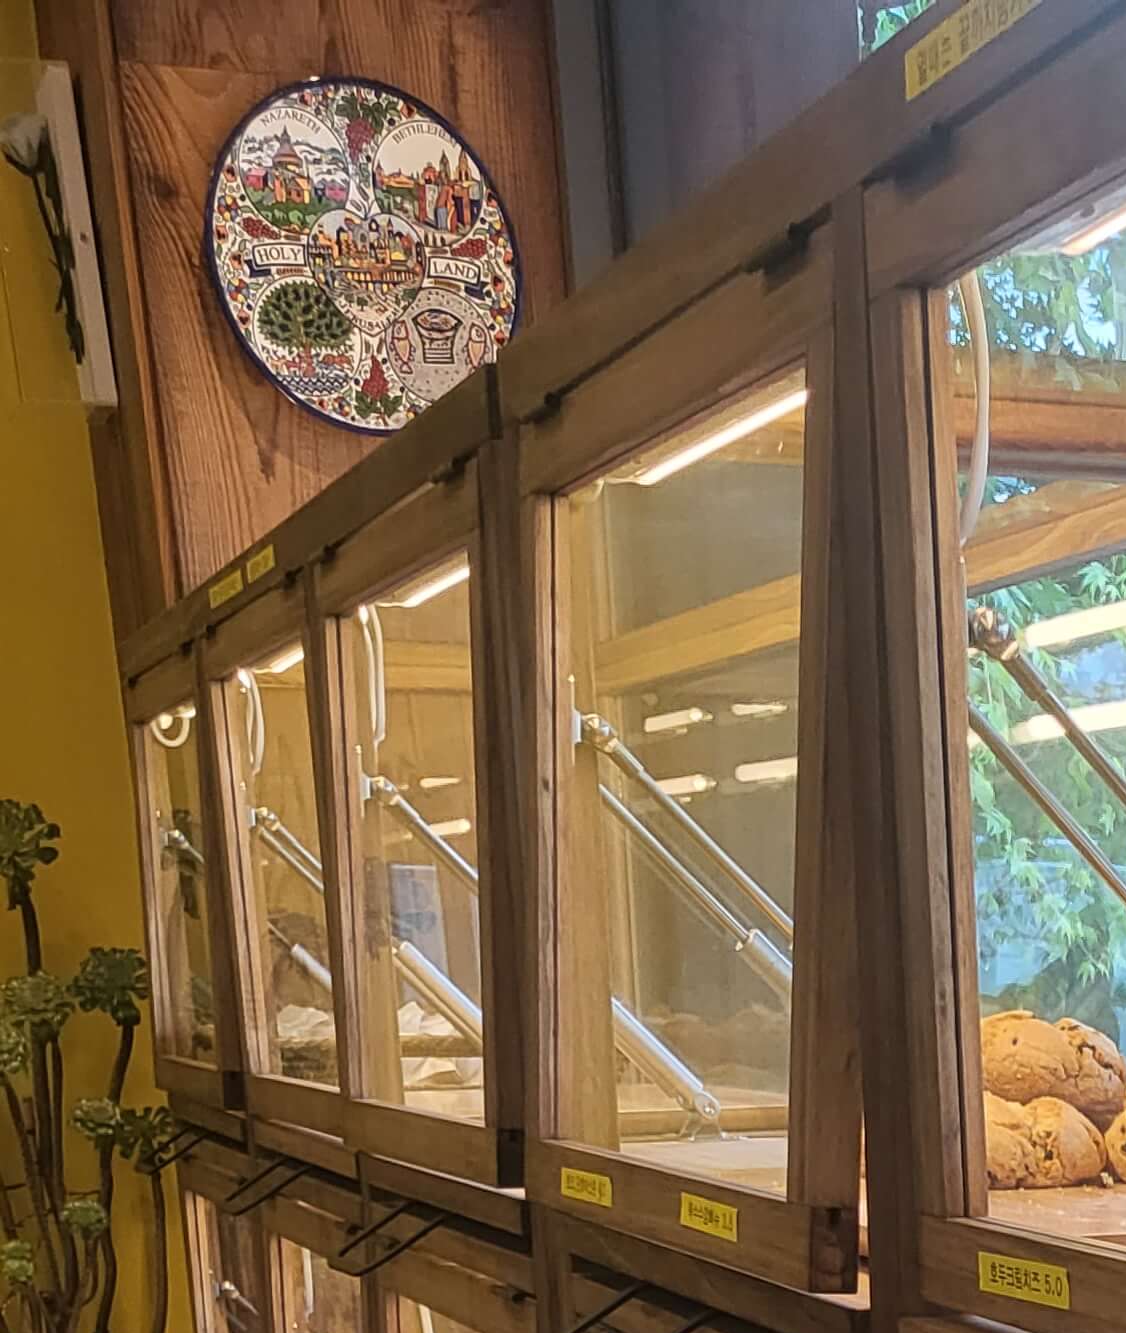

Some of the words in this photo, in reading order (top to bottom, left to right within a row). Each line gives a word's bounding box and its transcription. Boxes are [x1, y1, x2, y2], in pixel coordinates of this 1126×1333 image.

[260, 109, 322, 135] NAZARETH
[392, 123, 459, 147] BETHLEHE
[257, 247, 302, 263] HOLY
[433, 261, 478, 282] LAND
[1044, 1274, 1063, 1297] 5.0
